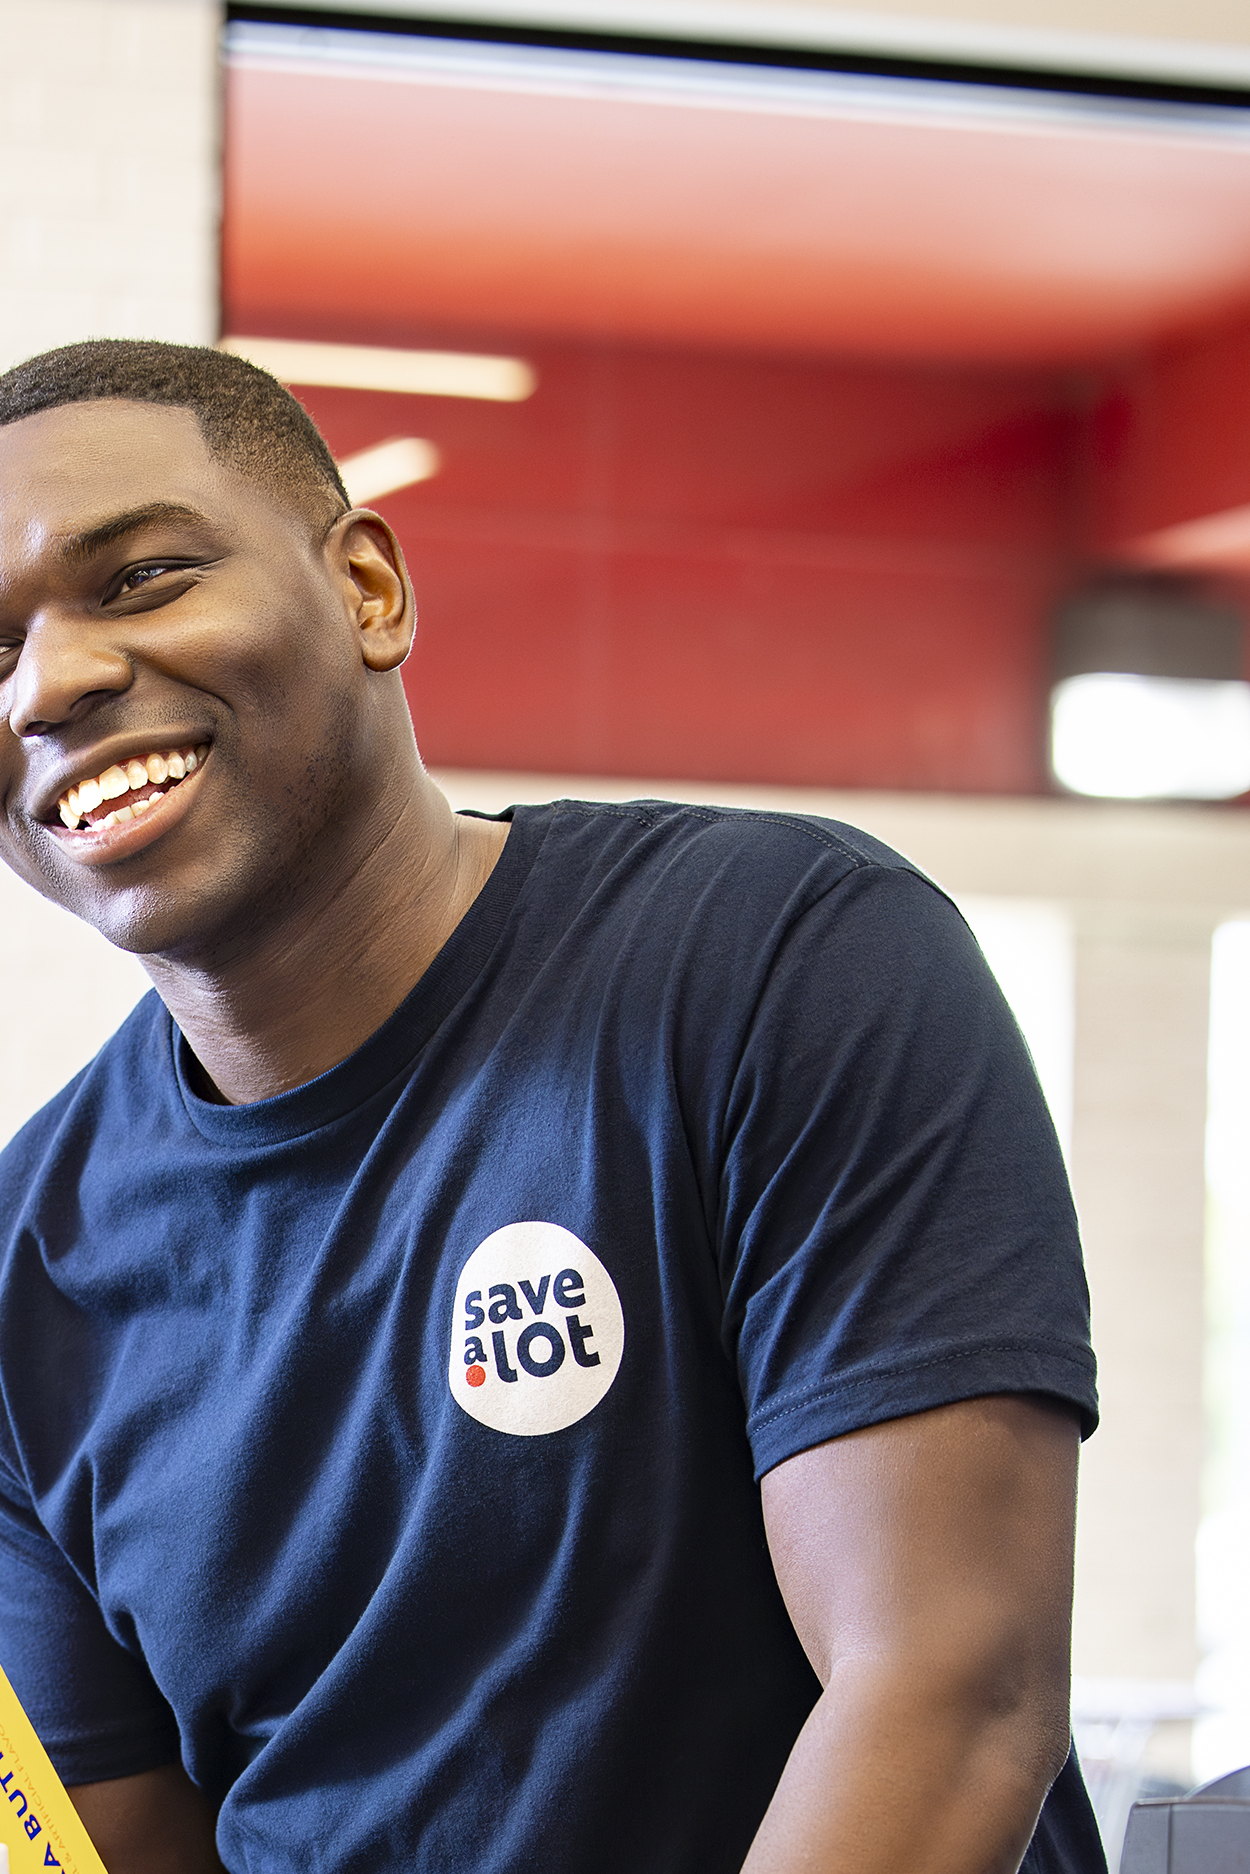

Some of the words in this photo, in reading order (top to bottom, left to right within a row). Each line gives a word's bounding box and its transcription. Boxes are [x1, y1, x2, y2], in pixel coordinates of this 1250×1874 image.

[464, 1268, 587, 1331] save
[463, 1336, 488, 1365] a
[491, 1314, 602, 1384] lot
[24, 1776, 66, 1850] ARTIFICIAL
